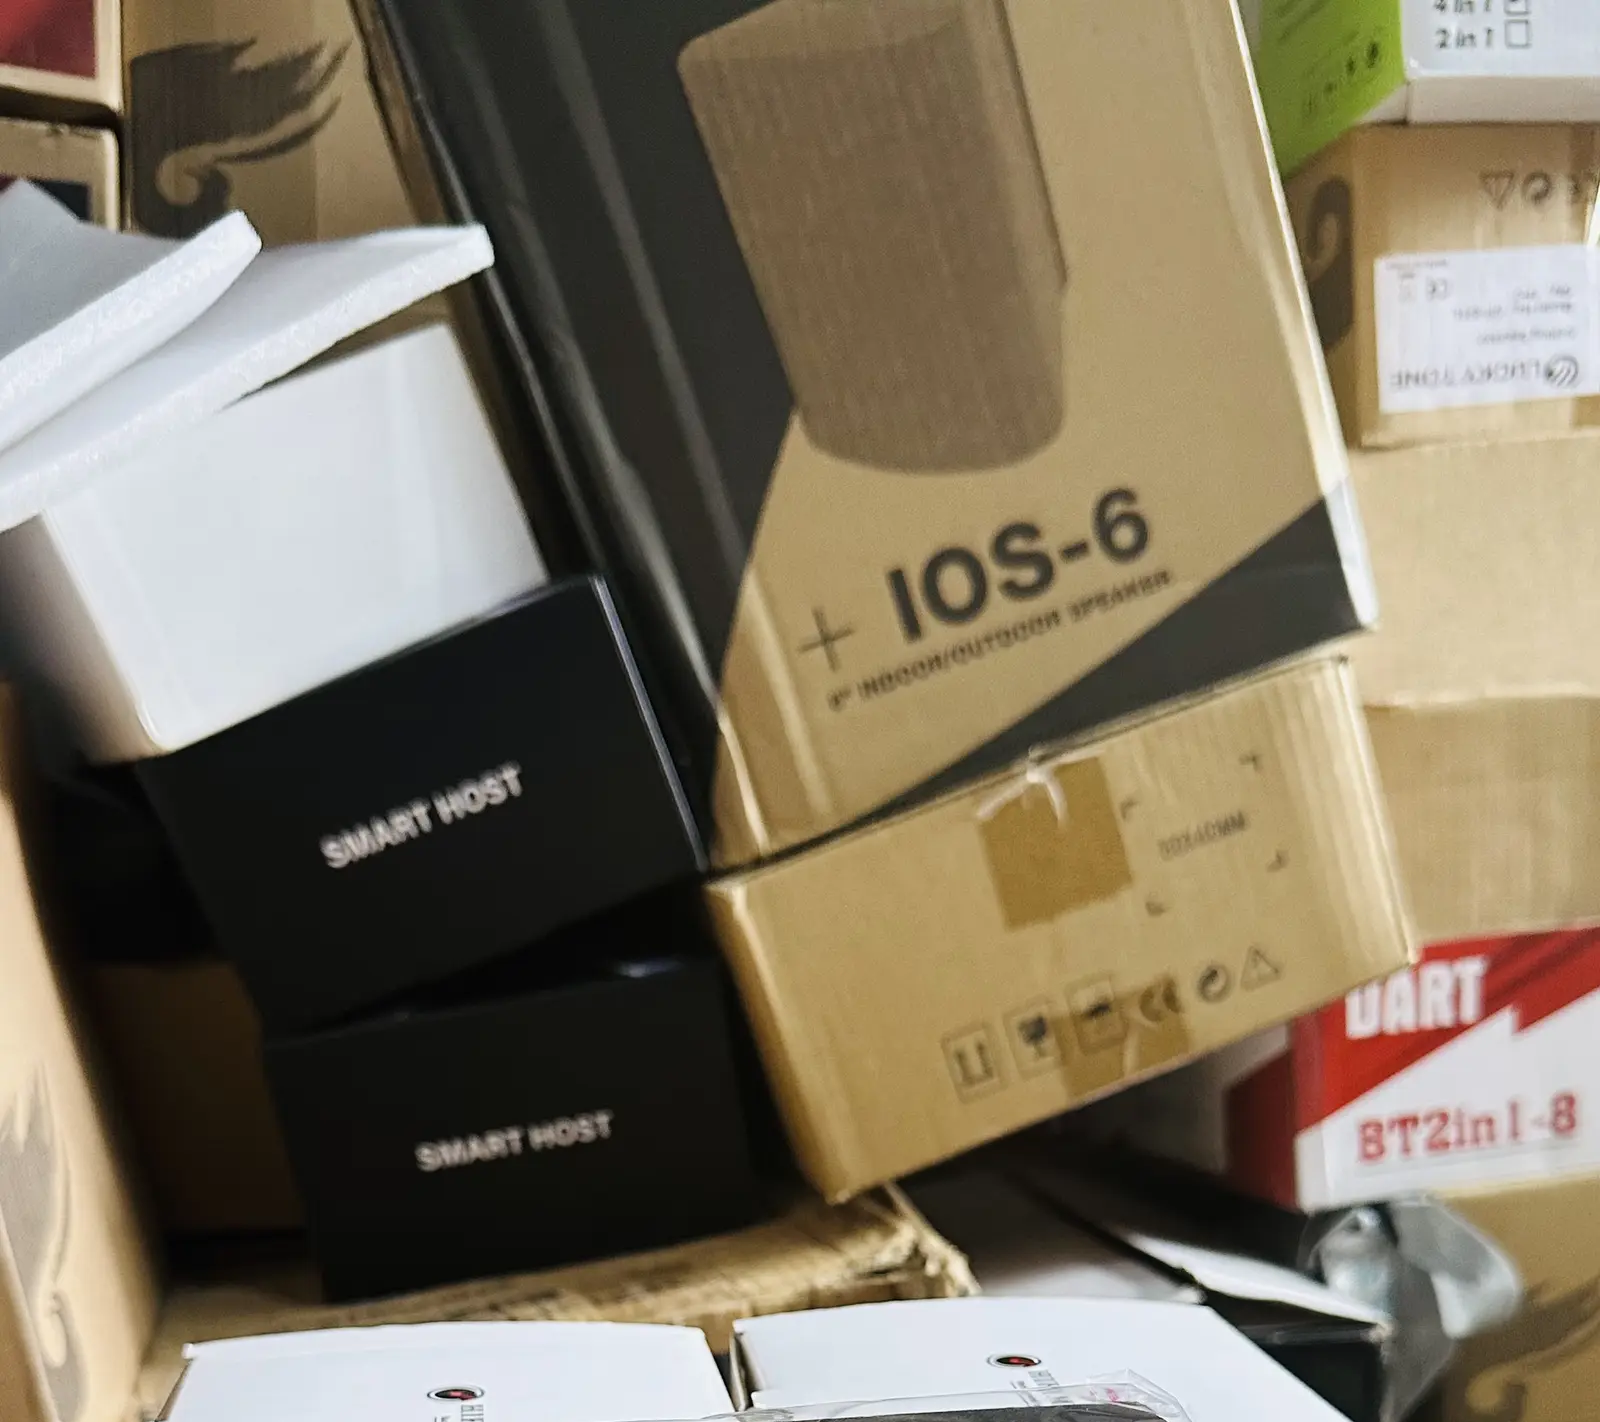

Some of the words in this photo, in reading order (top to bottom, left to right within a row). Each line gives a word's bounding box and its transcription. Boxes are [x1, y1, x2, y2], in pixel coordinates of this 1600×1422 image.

[1435, 28, 1450, 49] 2
[1454, 28, 1478, 48] in
[885, 486, 1151, 644] IOS-6
[319, 800, 434, 869] SMART
[432, 761, 523, 825] HOST
[414, 1127, 525, 1172] SMART
[527, 1109, 614, 1151] HOST
